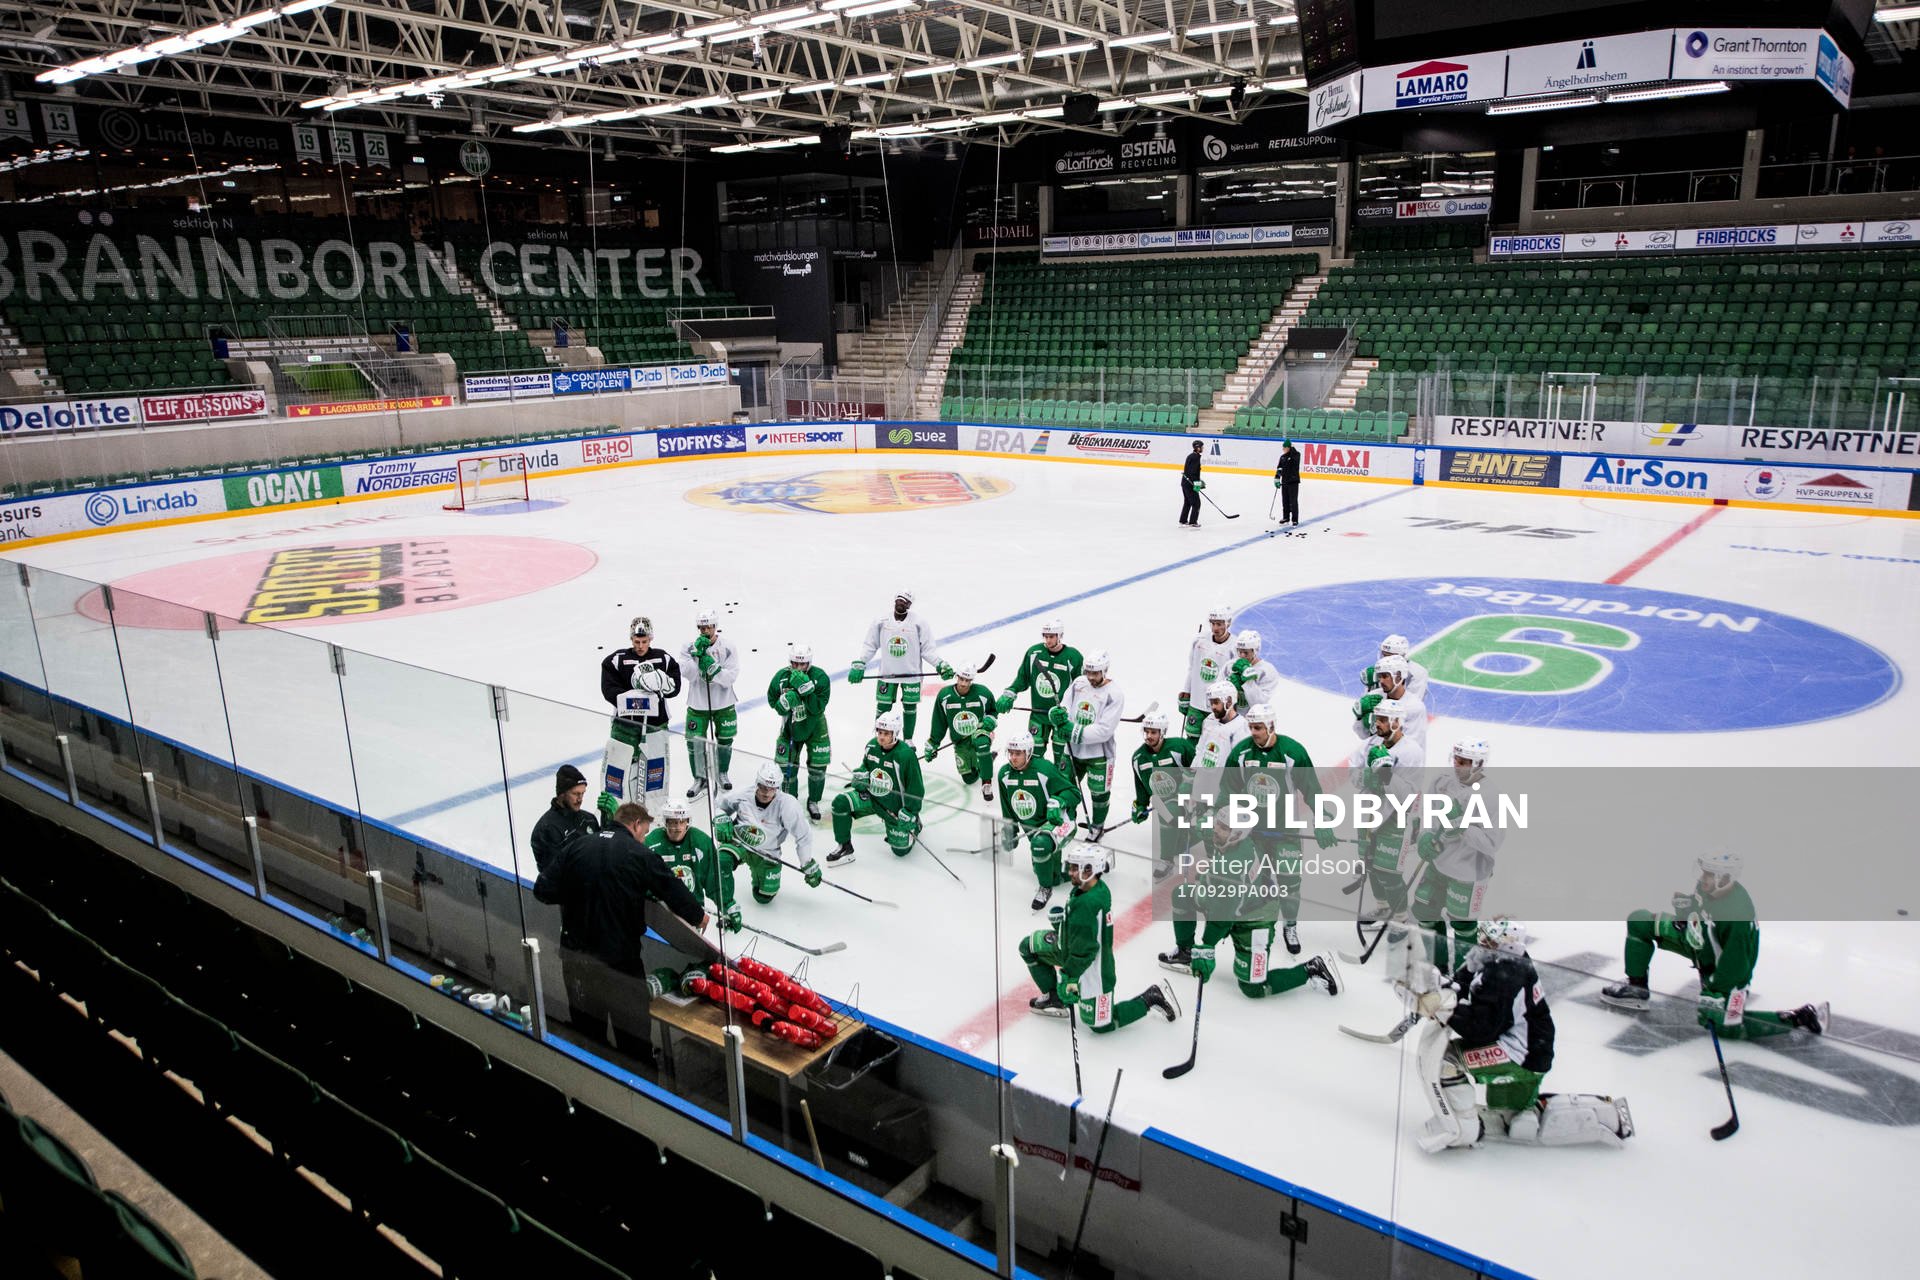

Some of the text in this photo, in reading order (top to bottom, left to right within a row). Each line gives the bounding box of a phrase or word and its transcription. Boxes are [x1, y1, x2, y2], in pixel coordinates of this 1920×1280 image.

[1713, 37, 1808, 53] Grant Thornton
[1712, 64, 1804, 77] An instinct for growth
[1396, 72, 1468, 97] LAMARO
[1544, 71, 1628, 90] Ängelholmshem
[1418, 92, 1468, 104] Service Partner
[49, 111, 70, 131] 13
[144, 120, 279, 151] Lindab Arena
[299, 133, 315, 150] 19
[333, 137, 352, 153] 25
[367, 139, 385, 156] 26
[1132, 138, 1177, 157] STENA
[1120, 155, 1178, 169] RECYCLING
[1399, 203, 1417, 217] LM
[1417, 201, 1441, 210] BYGG
[1458, 200, 1488, 211] Lindab
[173, 215, 234, 230] sektion N
[527, 230, 569, 241] sektion M
[978, 225, 1034, 241] LINDAHL
[1150, 234, 1173, 244] Lindab
[1226, 232, 1250, 241] Lindab
[1265, 230, 1290, 239] Lindab
[1696, 229, 1777, 245] FRIBROCKS
[1493, 236, 1561, 252] FRIBROCKS
[480, 241, 707, 300] CENTER
[513, 375, 534, 384] Golv
[537, 374, 550, 382] AB
[571, 370, 630, 383] CONTAINER
[634, 368, 663, 382] Diab
[670, 366, 697, 380] Diab
[700, 364, 726, 378] Diab
[580, 379, 622, 390] POOLEN
[147, 396, 252, 416] LEIF OLSSONS
[319, 398, 423, 415] FLAGGFABRIKEN KRONAN
[1, 402, 131, 431] Deloitte
[769, 431, 844, 444] INTERSPORT
[1451, 417, 1606, 442] RESPARTNER
[585, 439, 629, 458] ER-HO
[659, 433, 723, 453] SYDFRYS
[975, 429, 1026, 454] BRA
[1740, 427, 1920, 455] RESPARTNE
[499, 449, 559, 473] bravida
[596, 455, 620, 465] BYGG
[1303, 443, 1370, 469] MAXI
[367, 461, 417, 476] Tommy
[1315, 466, 1369, 476] STORMARKNAD
[1584, 457, 1708, 491] AirSon
[356, 467, 457, 493] NORDBERGHS
[1490, 478, 1540, 487] TRANSPORT
[247, 470, 322, 507] OCAY!
[1796, 488, 1873, 500] HVP-GRUPPEN.SE
[123, 490, 199, 516] Lindab
[194, 513, 409, 547] Scandic
[410, 539, 459, 605] BLADET
[242, 544, 400, 625] SPORT
[1424, 581, 1762, 634] NordicBet
[1467, 1048, 1503, 1063] ER-HO
